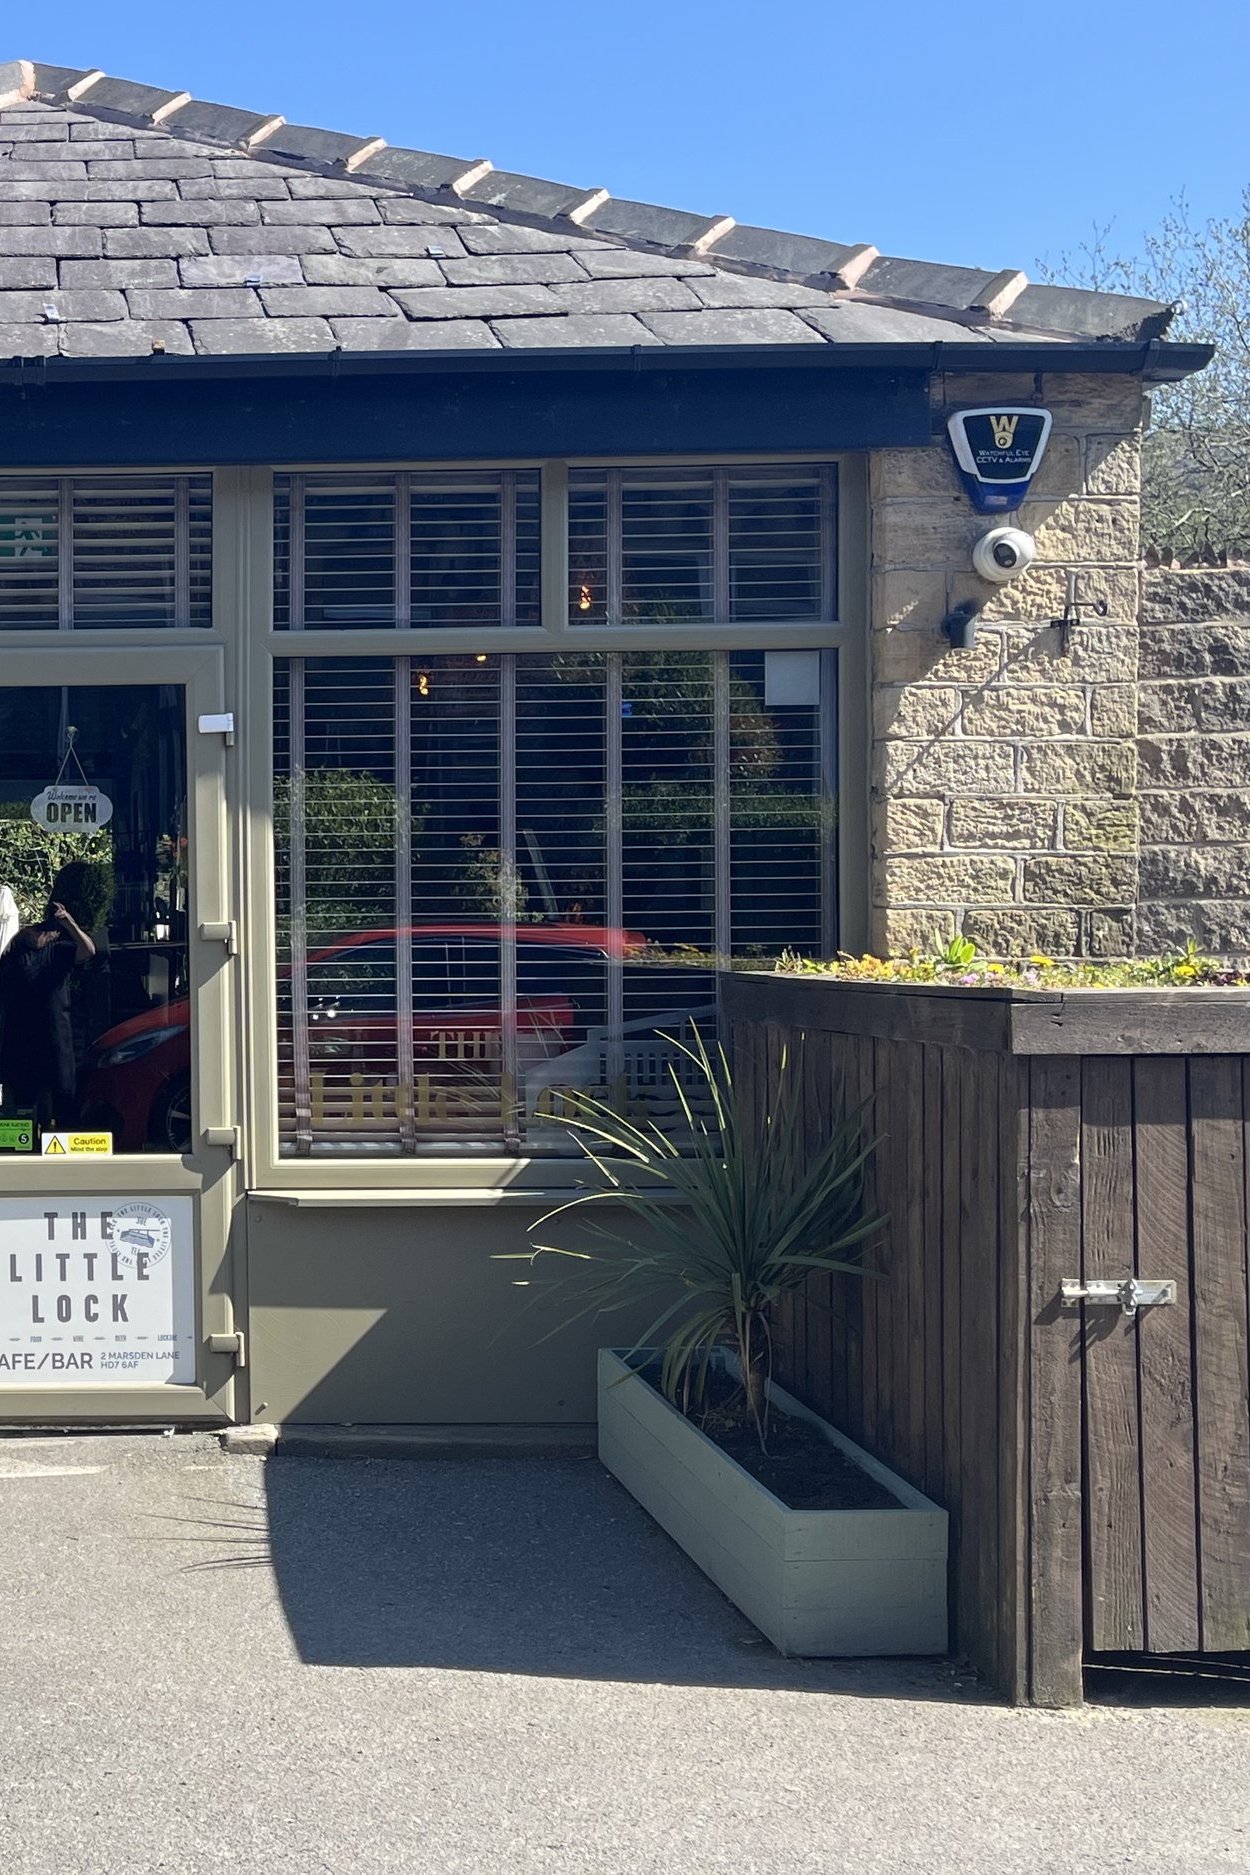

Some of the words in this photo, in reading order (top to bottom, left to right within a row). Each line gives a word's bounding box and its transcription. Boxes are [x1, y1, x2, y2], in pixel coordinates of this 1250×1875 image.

[976, 456, 998, 464] CCTV
[46, 802, 97, 824] OPEN
[73, 1137, 107, 1146] Caution
[43, 1211, 114, 1241] THE
[9, 1252, 150, 1283] LITTLE
[31, 1293, 129, 1324] LOCK
[100, 1352, 107, 1361] 2
[108, 1352, 154, 1361] MARSDEN
[155, 1351, 181, 1360] LANE
[100, 1361, 120, 1369] HD7
[121, 1361, 139, 1369] 6AF
